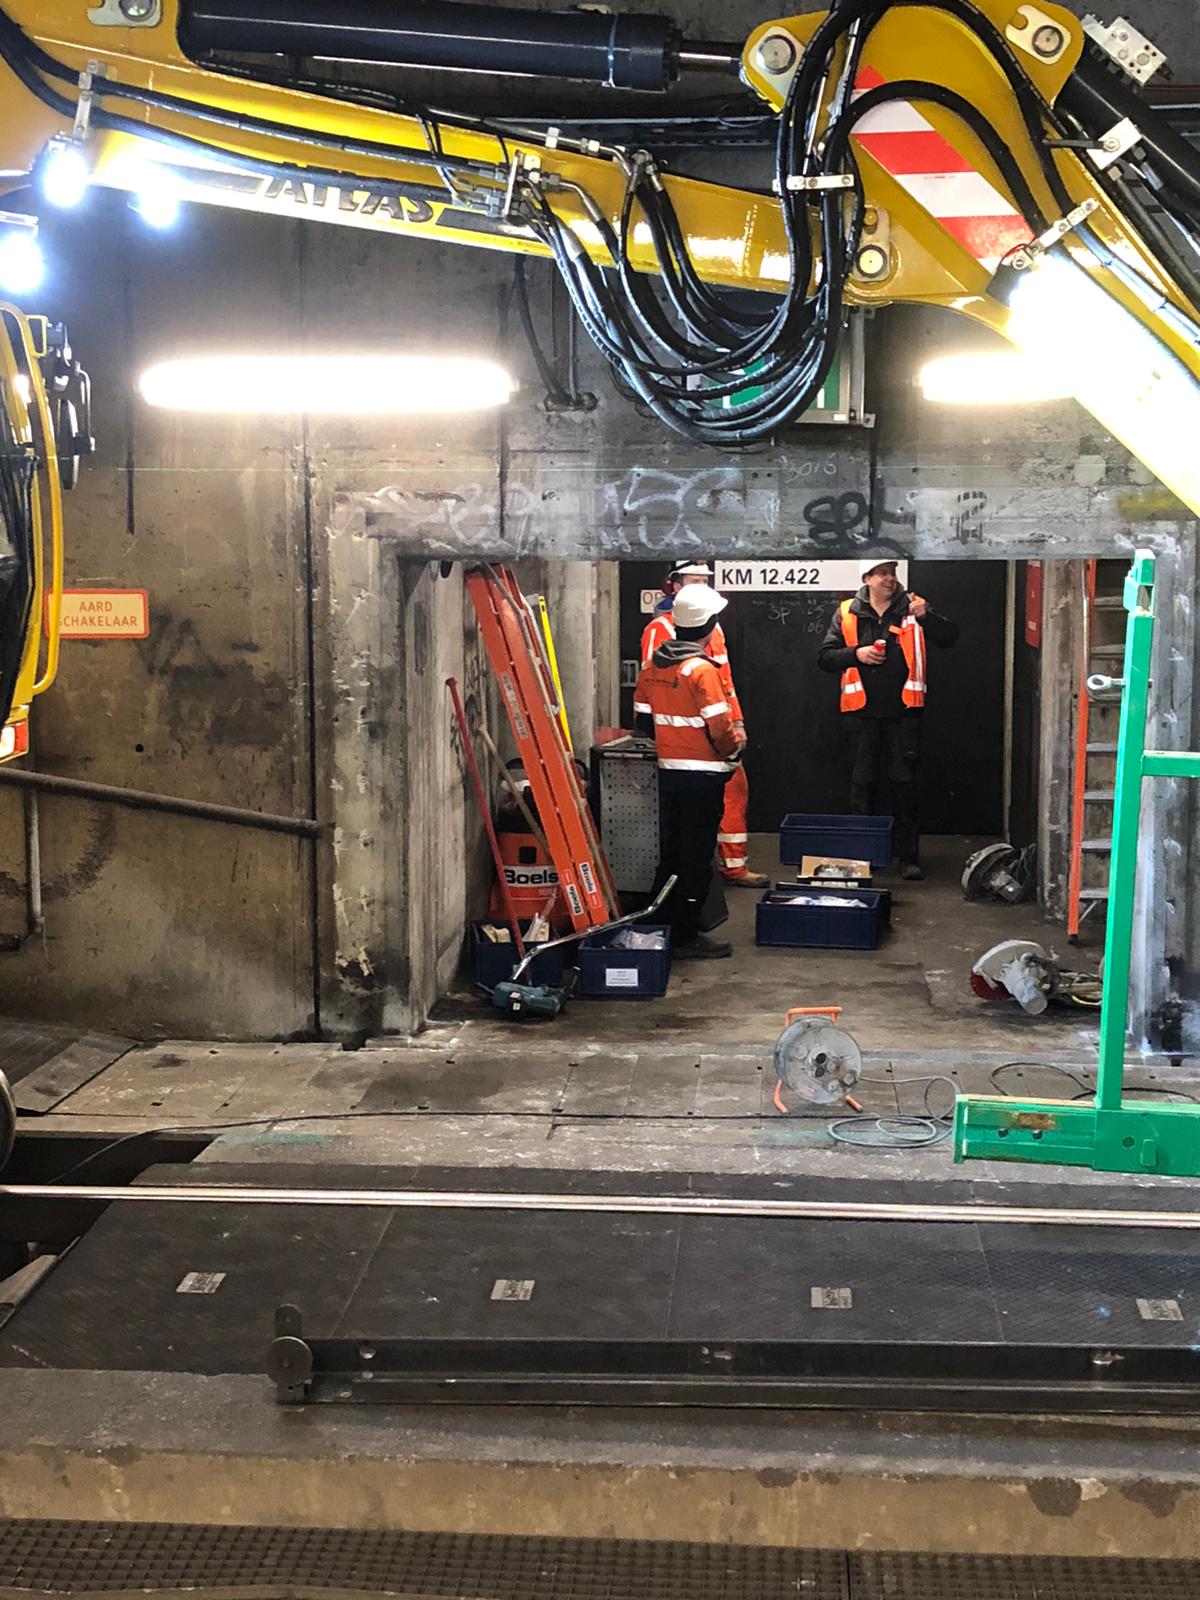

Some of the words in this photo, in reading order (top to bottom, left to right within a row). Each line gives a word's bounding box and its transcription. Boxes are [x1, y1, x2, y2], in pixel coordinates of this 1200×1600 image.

[722, 568, 752, 585] KM
[760, 568, 820, 585] 12.422
[79, 601, 113, 612] AARD
[504, 869, 559, 884] Boels
